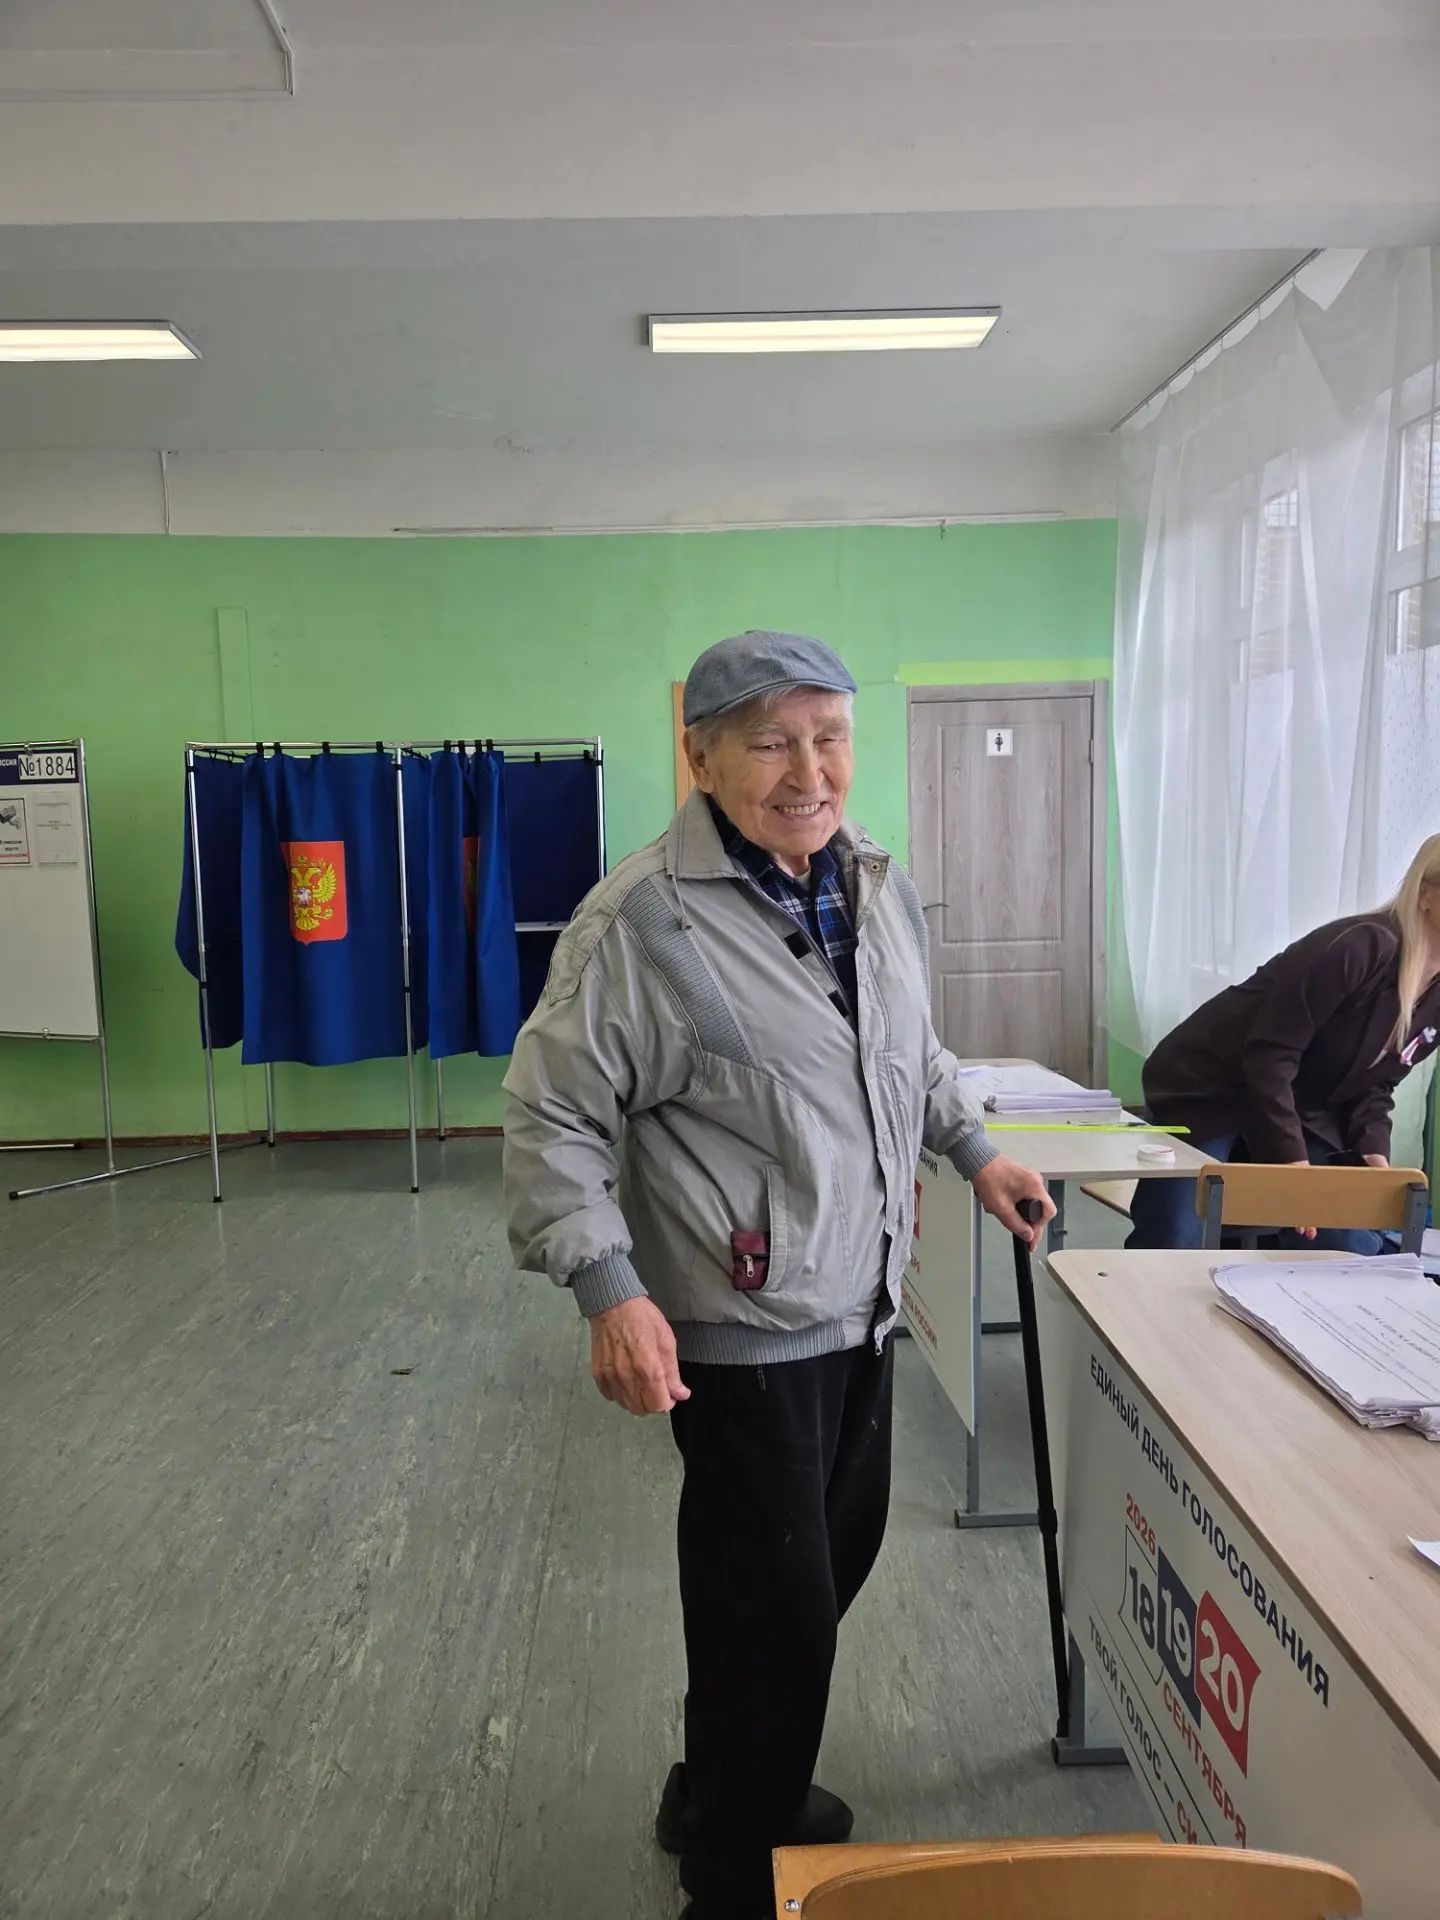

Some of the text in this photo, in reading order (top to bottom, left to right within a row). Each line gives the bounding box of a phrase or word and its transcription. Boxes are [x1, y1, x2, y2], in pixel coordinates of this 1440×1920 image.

[19, 756, 75, 776] №1884
[1091, 1353, 1329, 1707] ЕДИНЫЙ ДЕНЬ ГОЛОСОВАНИЯ
[1126, 1492, 1156, 1556] 2026
[1089, 1615, 1118, 1691] ТВОЙ
[1120, 1680, 1162, 1781] ГОЛОС
[1129, 1565, 1245, 1732] 18 19 20
[1163, 1681, 1247, 1849] СЕНТЯБРЯ
